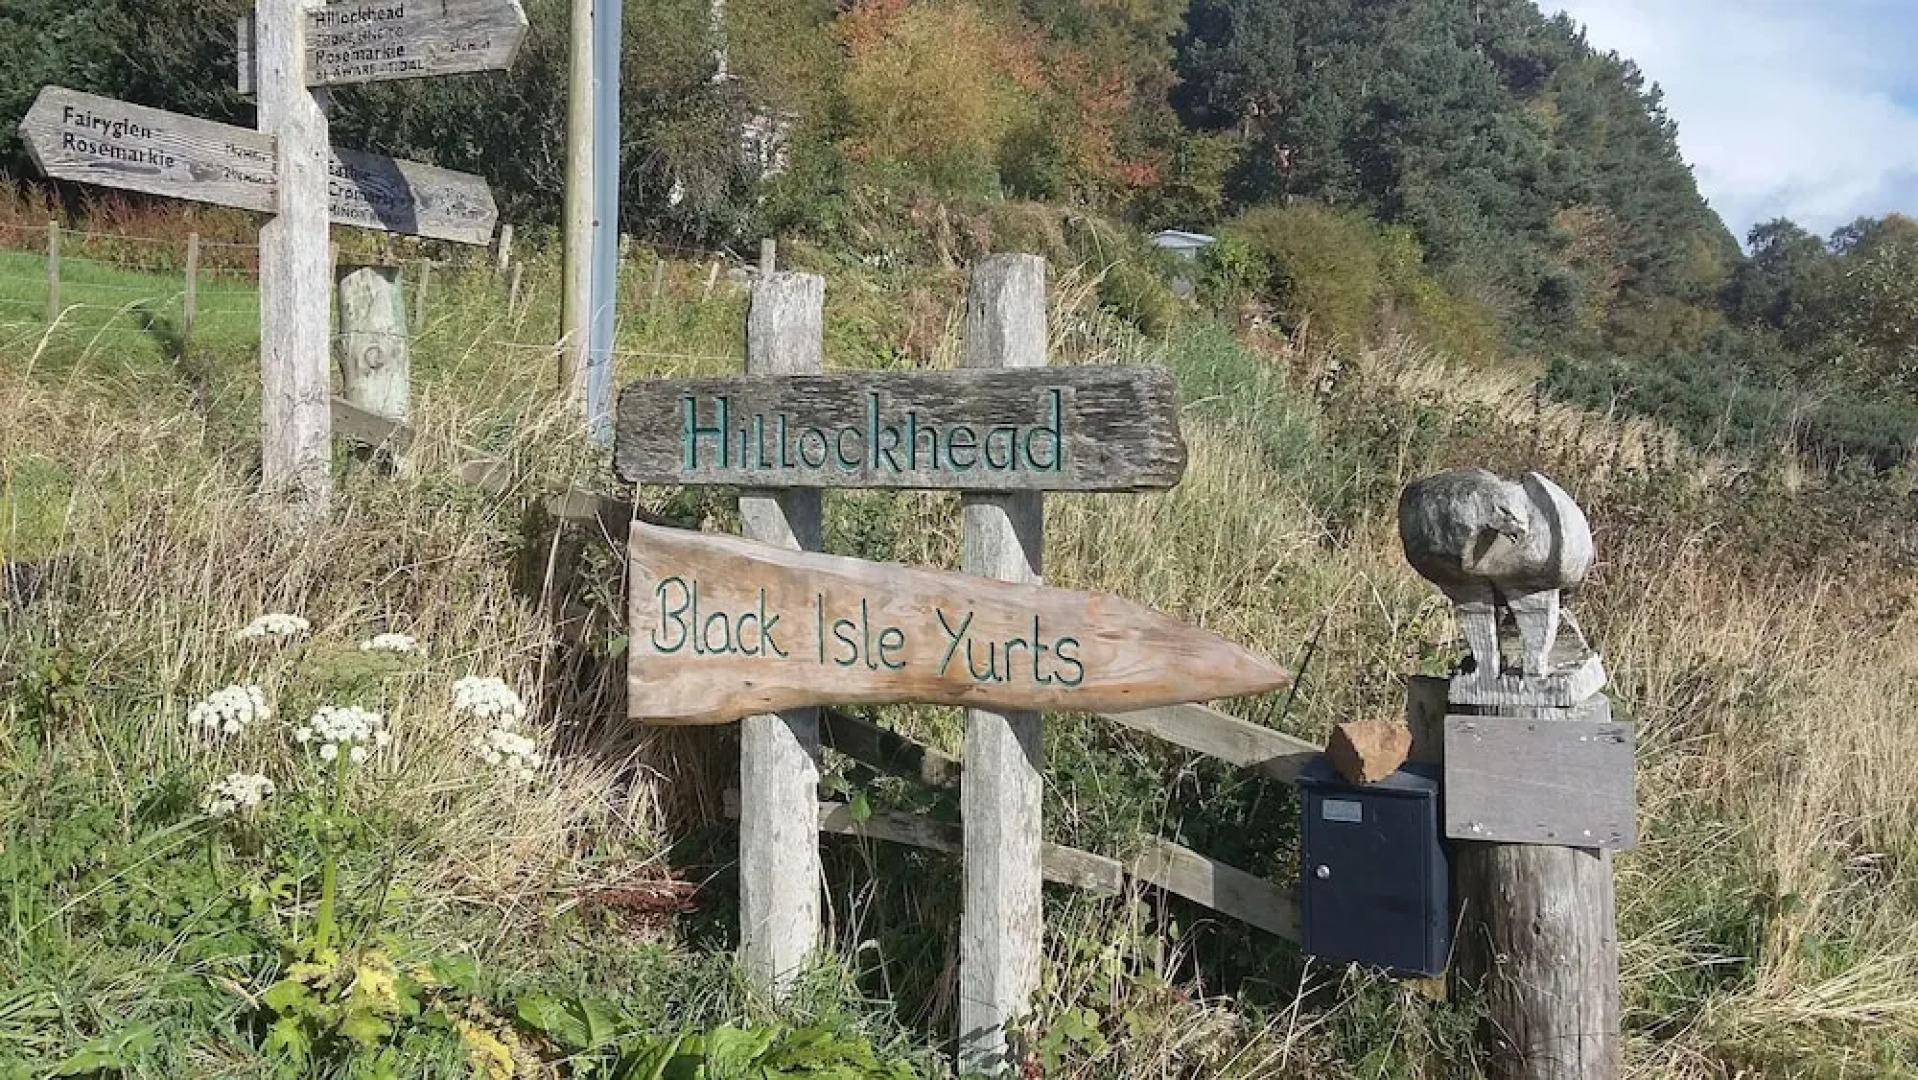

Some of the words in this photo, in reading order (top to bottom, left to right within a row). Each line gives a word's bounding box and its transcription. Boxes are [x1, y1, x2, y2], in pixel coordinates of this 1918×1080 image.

[316, 3, 404, 27] Hillockhead
[316, 42, 405, 65] Rosemarkie
[62, 104, 152, 138] Fairyglen
[62, 131, 175, 168] Rosemarkie
[682, 389, 1062, 474] Hillockhead
[652, 577, 788, 657] Black
[817, 593, 905, 672] Isle
[936, 607, 1086, 686] Yurts
